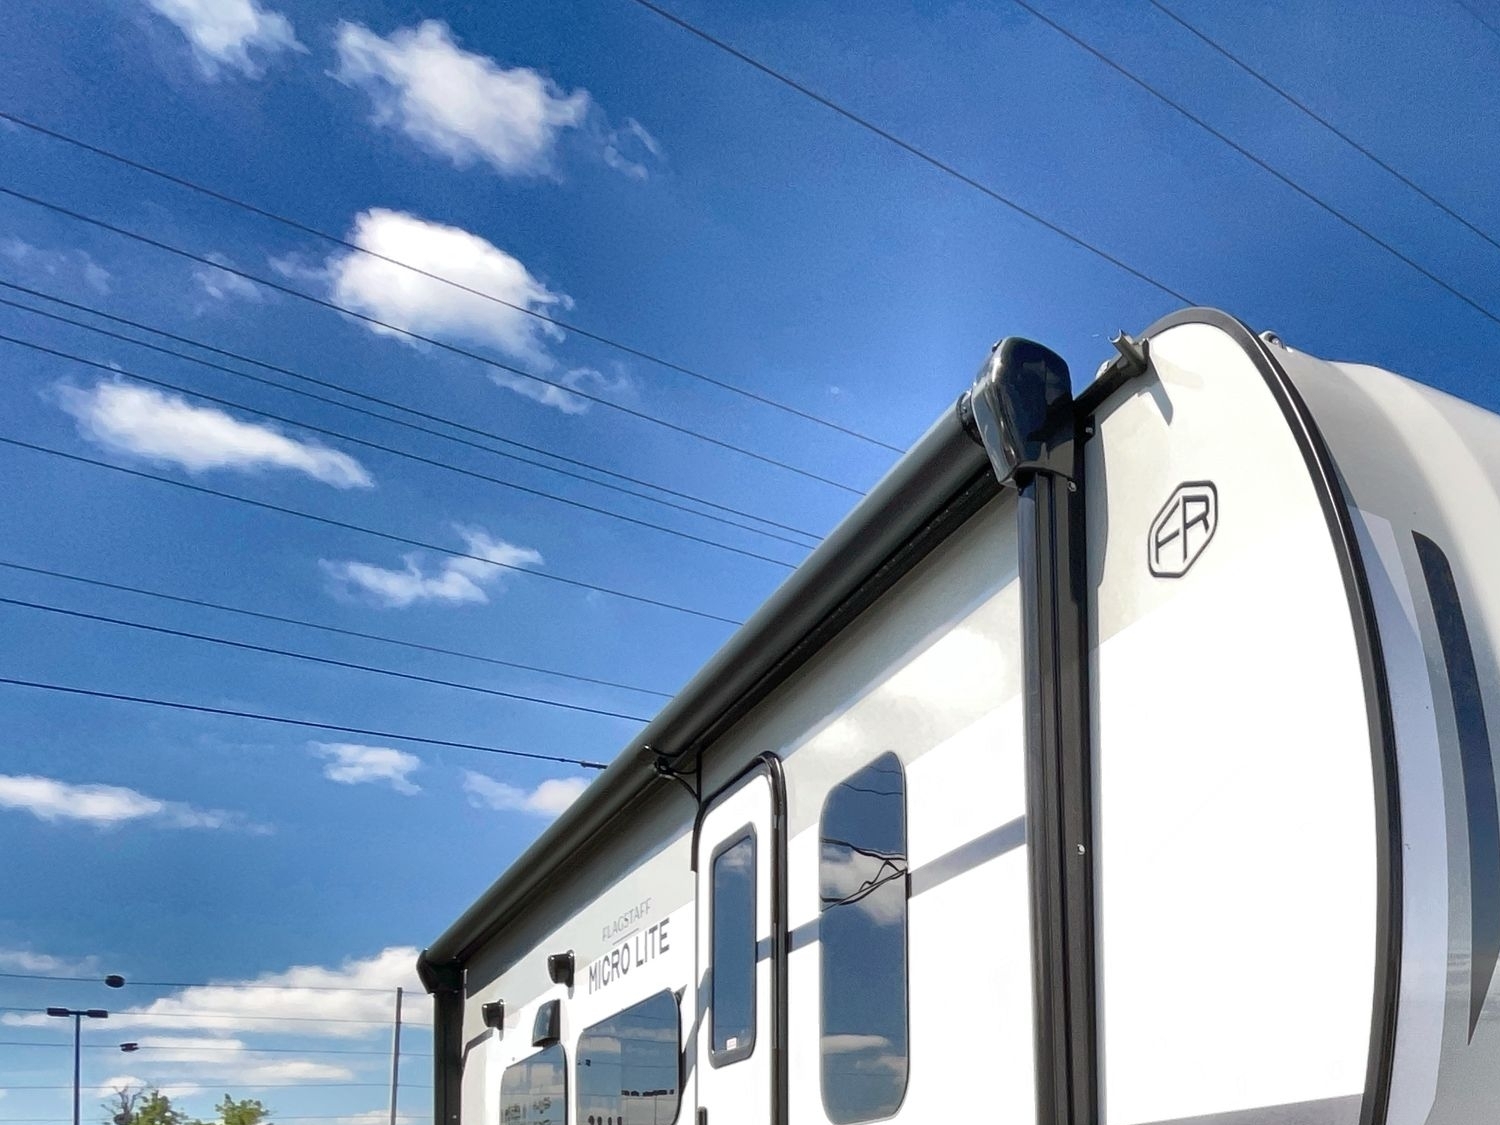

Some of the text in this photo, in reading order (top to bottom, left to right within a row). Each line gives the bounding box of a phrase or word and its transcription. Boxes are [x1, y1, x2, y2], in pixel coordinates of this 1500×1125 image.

[601, 897, 652, 941] FLAGSTAFF
[589, 917, 670, 995] MICRO LITE
